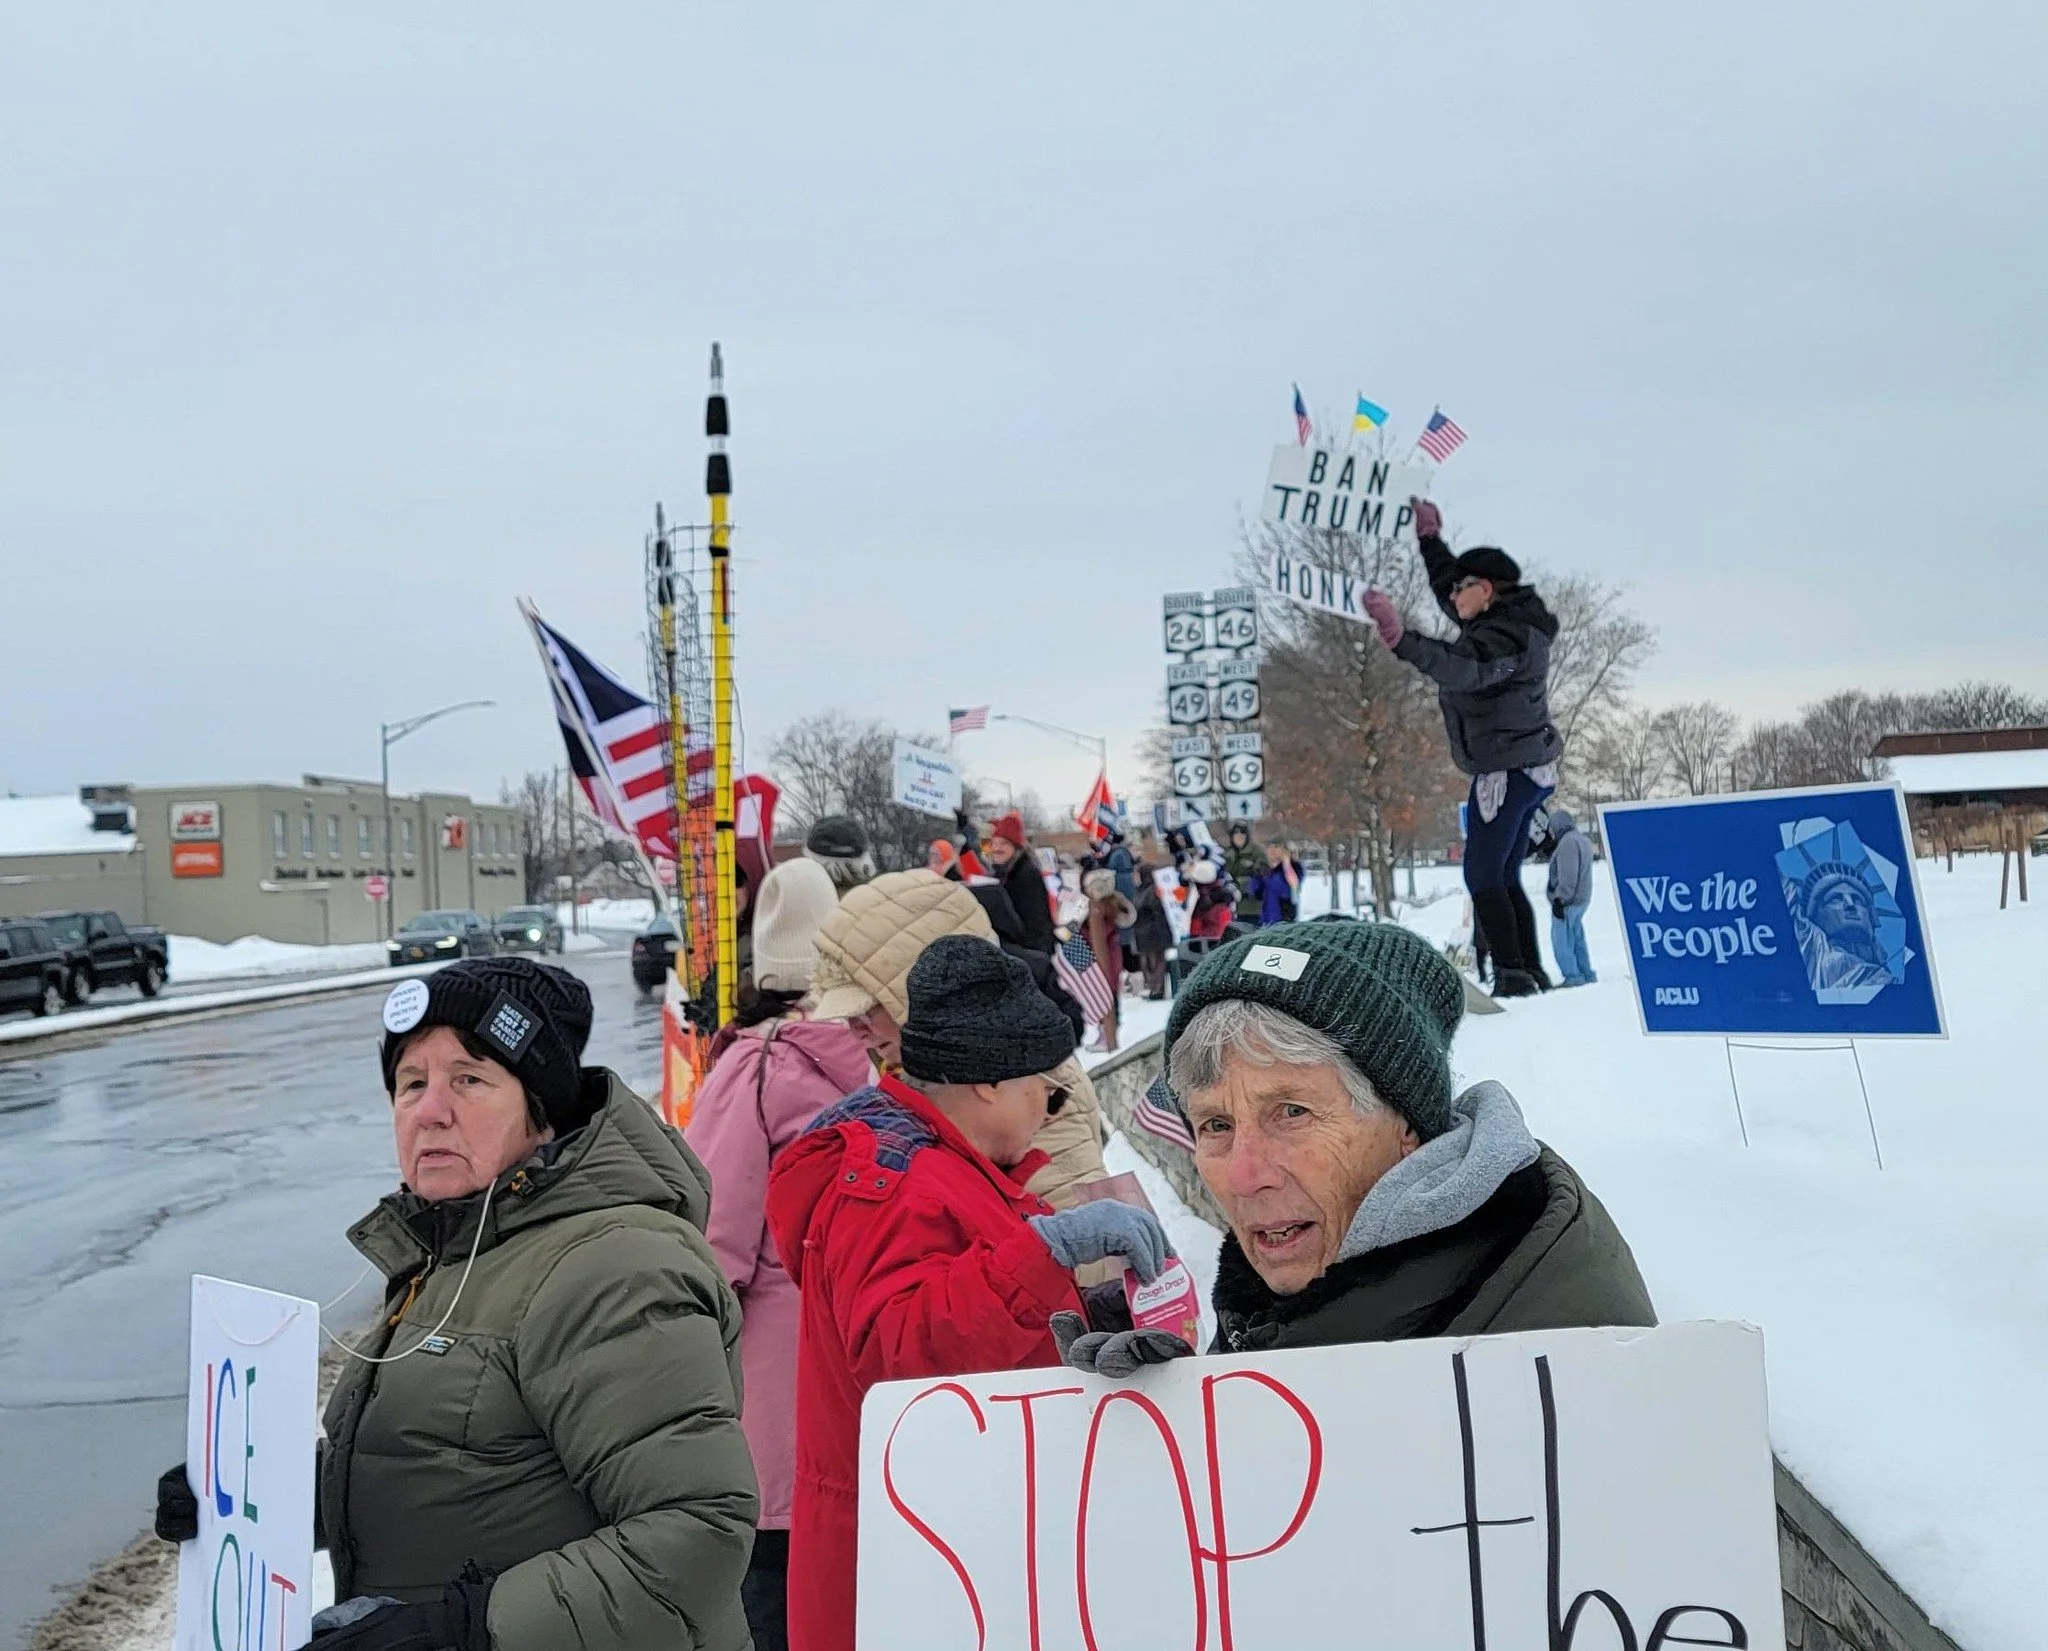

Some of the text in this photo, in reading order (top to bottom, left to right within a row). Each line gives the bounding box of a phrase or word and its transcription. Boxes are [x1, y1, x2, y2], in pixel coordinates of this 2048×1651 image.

[1309, 450, 1390, 496] BAN
[1273, 484, 1413, 538] TRUMP
[1276, 555, 1356, 614] HONK
[1166, 595, 1203, 609] SOUTH
[1217, 591, 1254, 605] SOUTH
[1169, 622, 1202, 644] 26
[1219, 618, 1253, 640] 46
[1173, 665, 1202, 679] EAST
[1223, 661, 1253, 675] WEST
[1175, 692, 1204, 714] 49
[1226, 688, 1254, 712] 49
[1177, 739, 1205, 752] EAST
[1226, 736, 1256, 749] WEST
[1178, 765, 1208, 787] 69
[1228, 761, 1258, 784] 69
[1625, 871, 1757, 914] We the
[1636, 916, 1777, 964] People
[1655, 986, 1700, 1006] ACLU
[497, 1010, 525, 1037] NOT A
[502, 1003, 531, 1030] HATE IS
[490, 1023, 517, 1050] VALUE
[492, 1017, 523, 1042] FAMILY
[1137, 1284, 1164, 1301] Cough
[1164, 1276, 1186, 1292] Drops
[204, 1358, 259, 1524] ICE
[882, 1370, 1324, 1651] STOP
[212, 1532, 298, 1651] OUT
